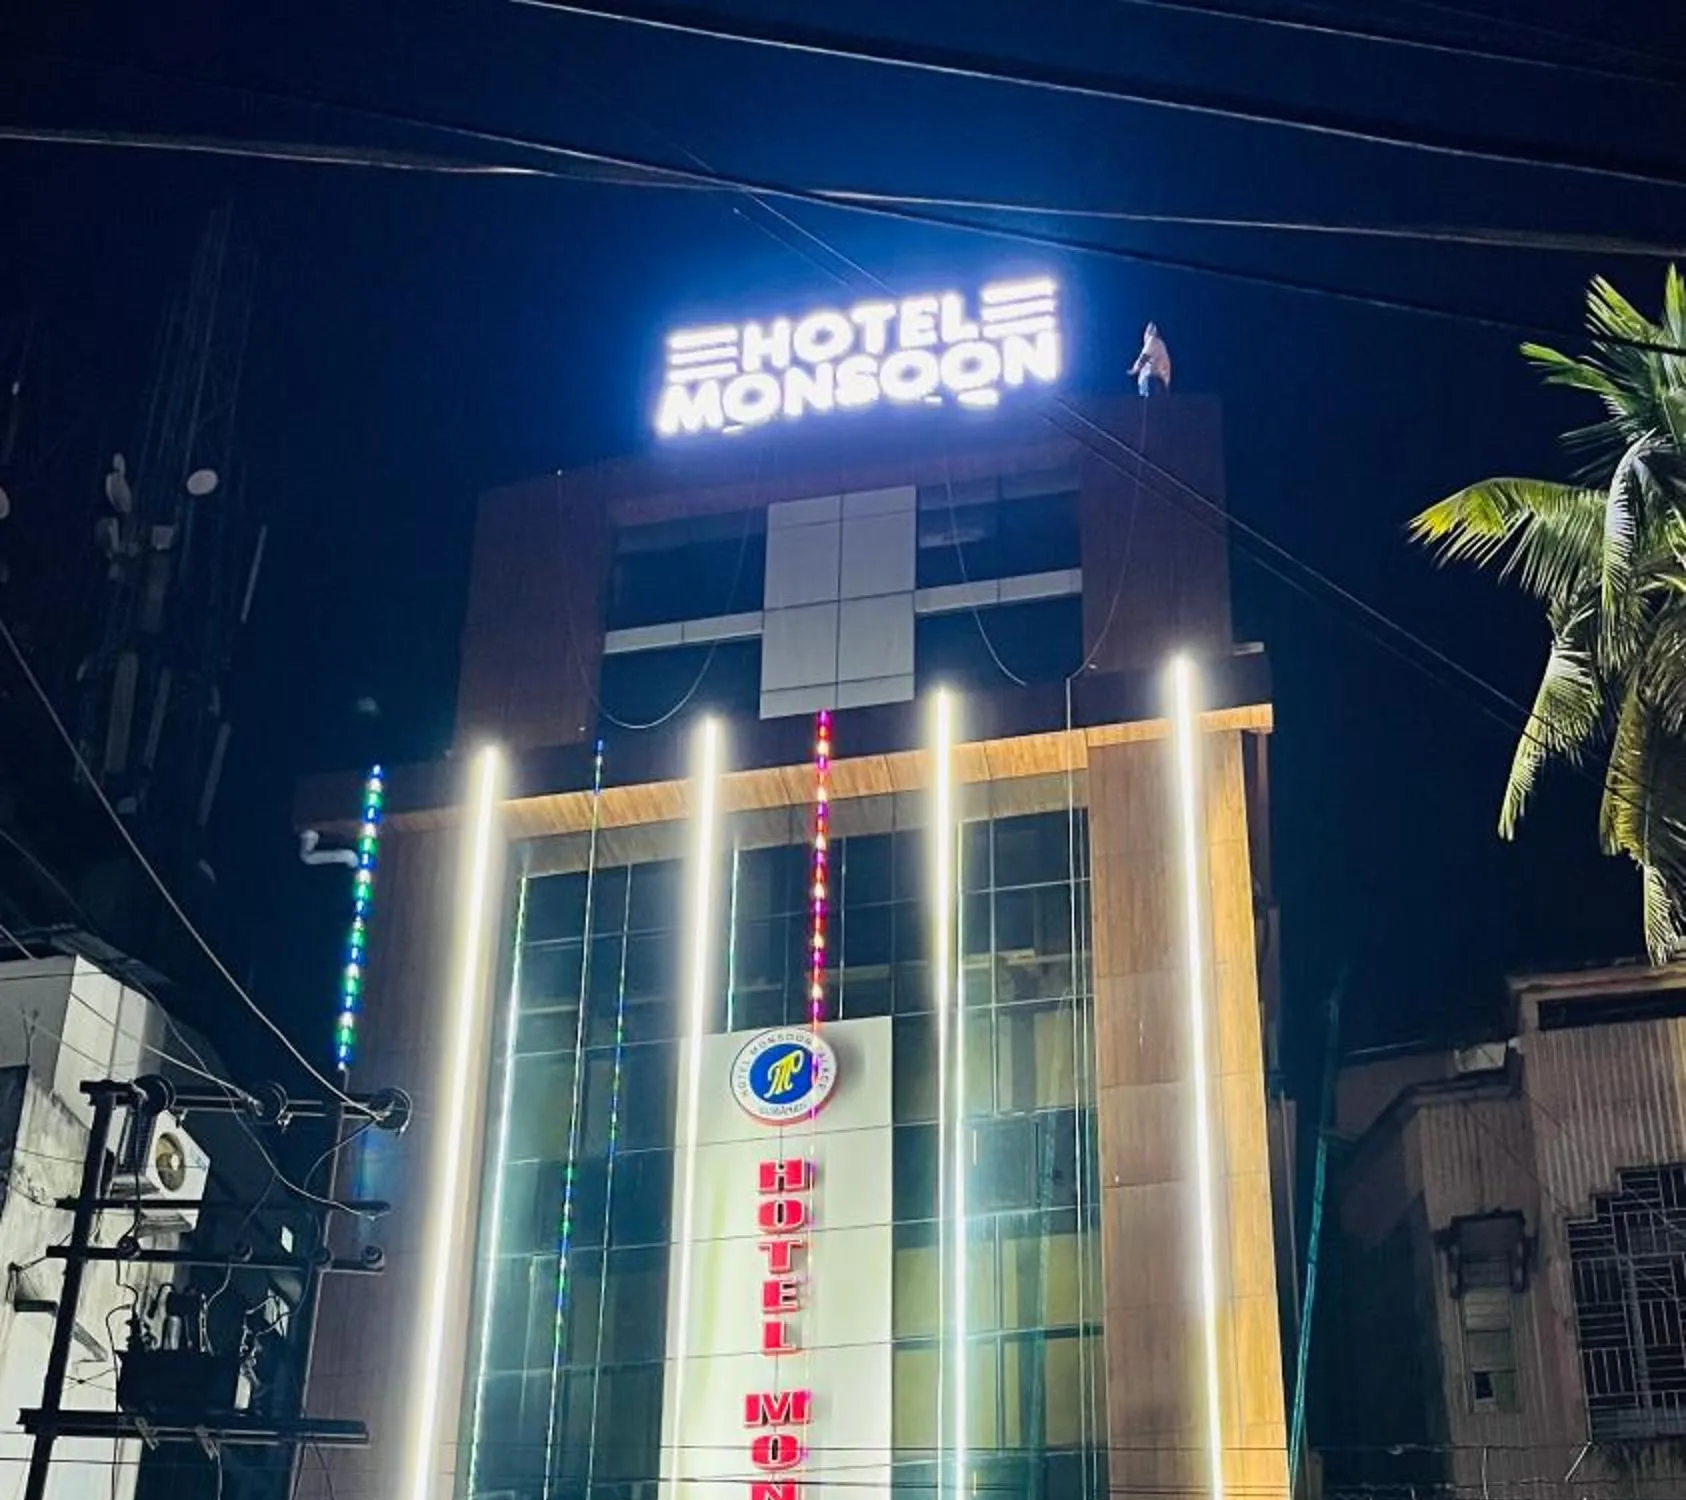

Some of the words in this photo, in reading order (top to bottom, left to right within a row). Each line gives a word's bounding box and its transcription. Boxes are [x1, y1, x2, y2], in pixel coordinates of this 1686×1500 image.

[656, 331, 1058, 436] MONSOON
[741, 292, 980, 372] HOTEL
[757, 1157, 809, 1355] HOTEL
